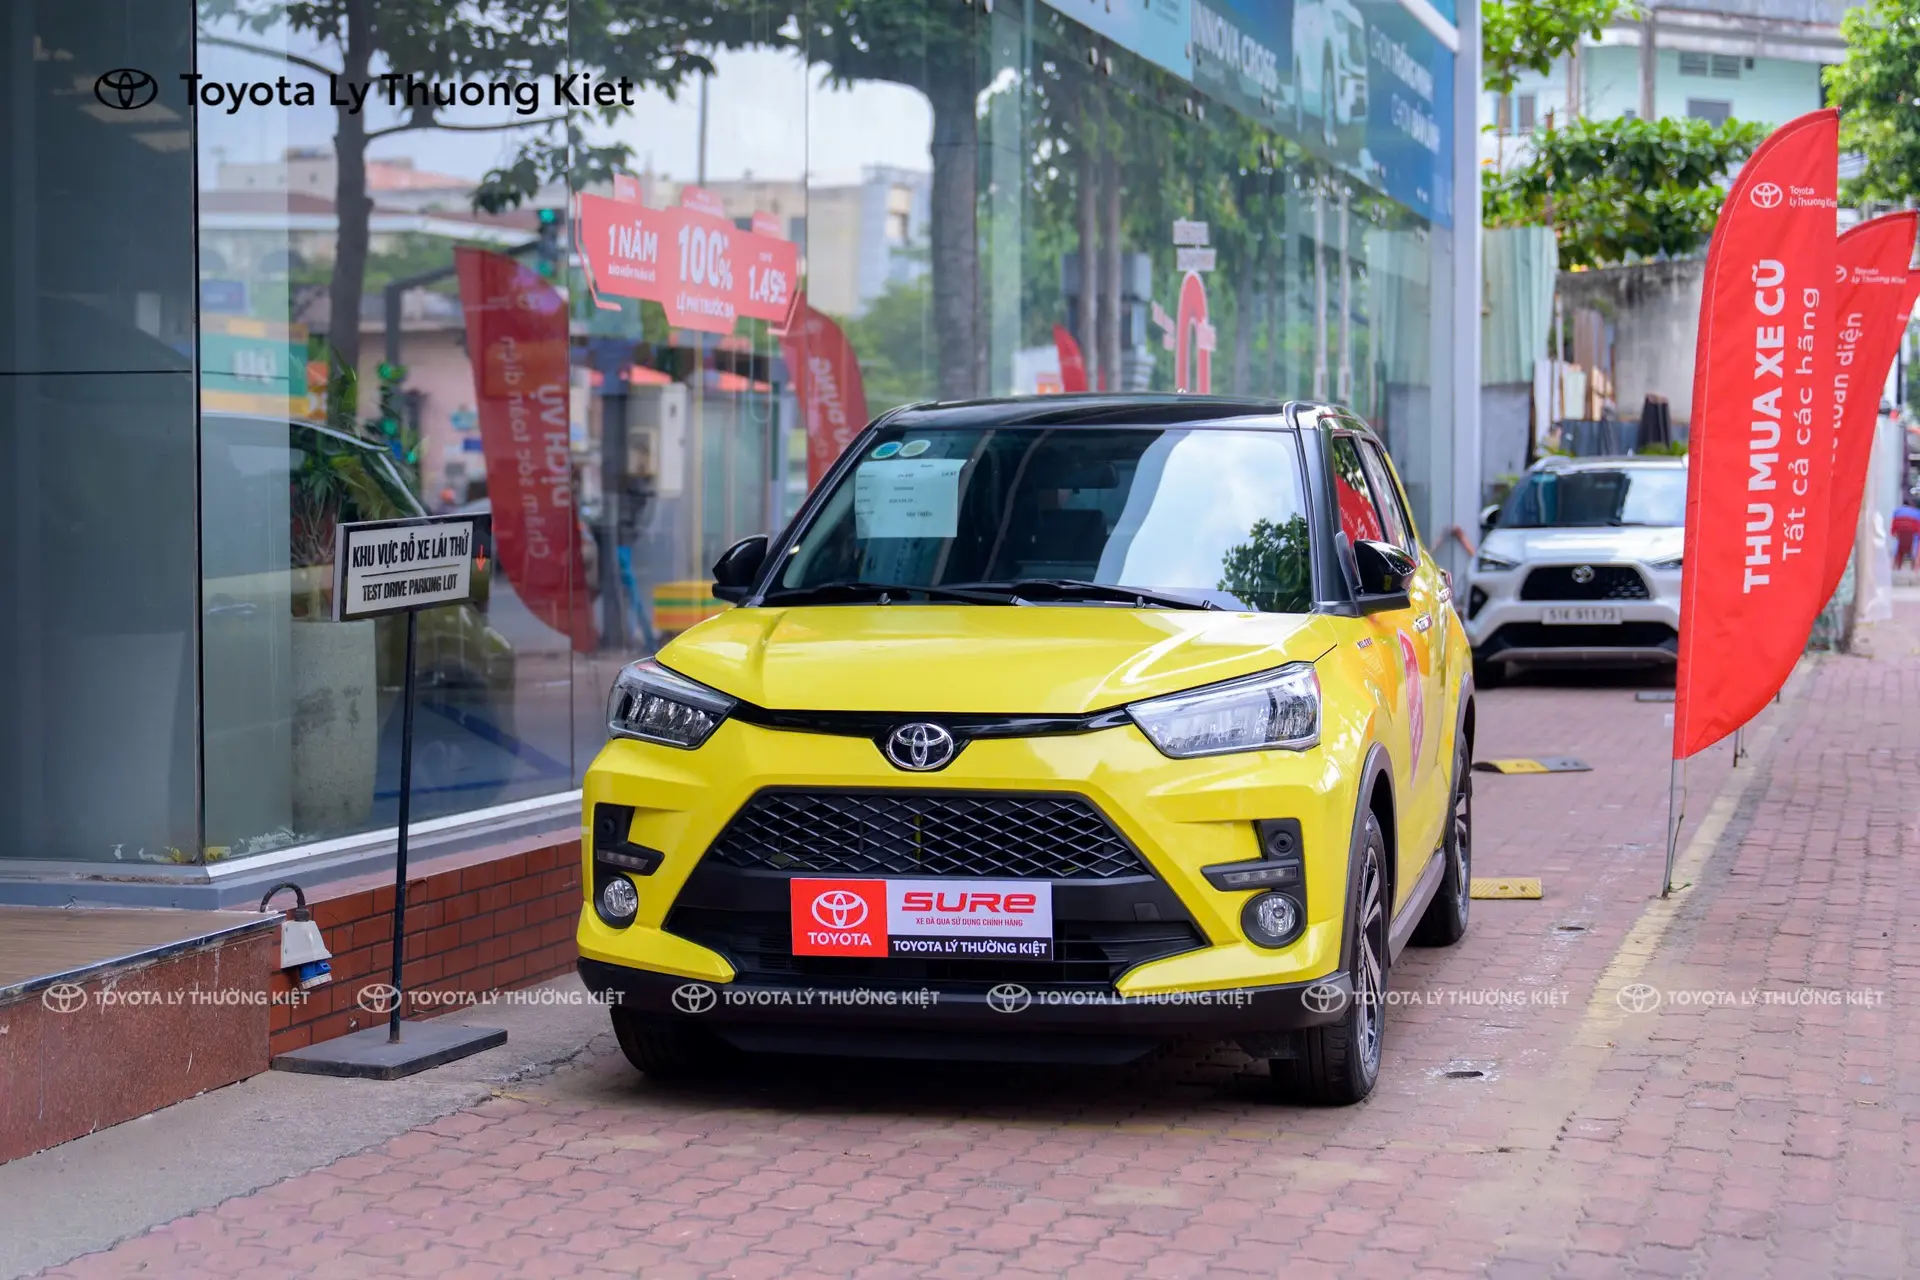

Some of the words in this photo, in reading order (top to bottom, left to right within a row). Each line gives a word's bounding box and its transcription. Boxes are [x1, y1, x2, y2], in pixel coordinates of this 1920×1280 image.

[1788, 185, 1815, 197] Toyota
[1798, 196, 1825, 209] Thuong
[608, 224, 616, 257] 1
[618, 219, 658, 264] NĂM
[1751, 259, 1786, 316] CŨ
[1754, 325, 1785, 380] XE
[1795, 287, 1820, 374] hãng
[1835, 312, 1864, 366] diện
[1793, 387, 1813, 445] các
[1747, 386, 1783, 492] MUA
[1788, 458, 1810, 496] cả
[352, 545, 375, 568] KHU
[378, 540, 399, 569] VỰC
[400, 532, 415, 563] ĐỖ
[417, 539, 430, 561] XE
[432, 533, 447, 559] LÁI
[449, 528, 470, 557] THỬ
[1743, 502, 1775, 593] THU
[1782, 507, 1806, 561] Tất
[362, 583, 383, 602] TEST
[384, 579, 407, 599] DRIVE
[409, 577, 442, 596] PARKING
[443, 574, 458, 591] LOT
[808, 931, 872, 946] TOYOTA
[915, 917, 925, 925] XE
[926, 916, 935, 925] ĐÃ
[936, 918, 951, 927] QUA
[951, 916, 961, 926] SỬ
[962, 919, 981, 928] DỤNG
[982, 917, 1003, 927] CHÍNH
[893, 940, 943, 952] TOYOTA
[945, 938, 959, 953] LÝ
[960, 939, 1017, 954] THƯỜNG
[1019, 940, 1048, 957] KIỆT
